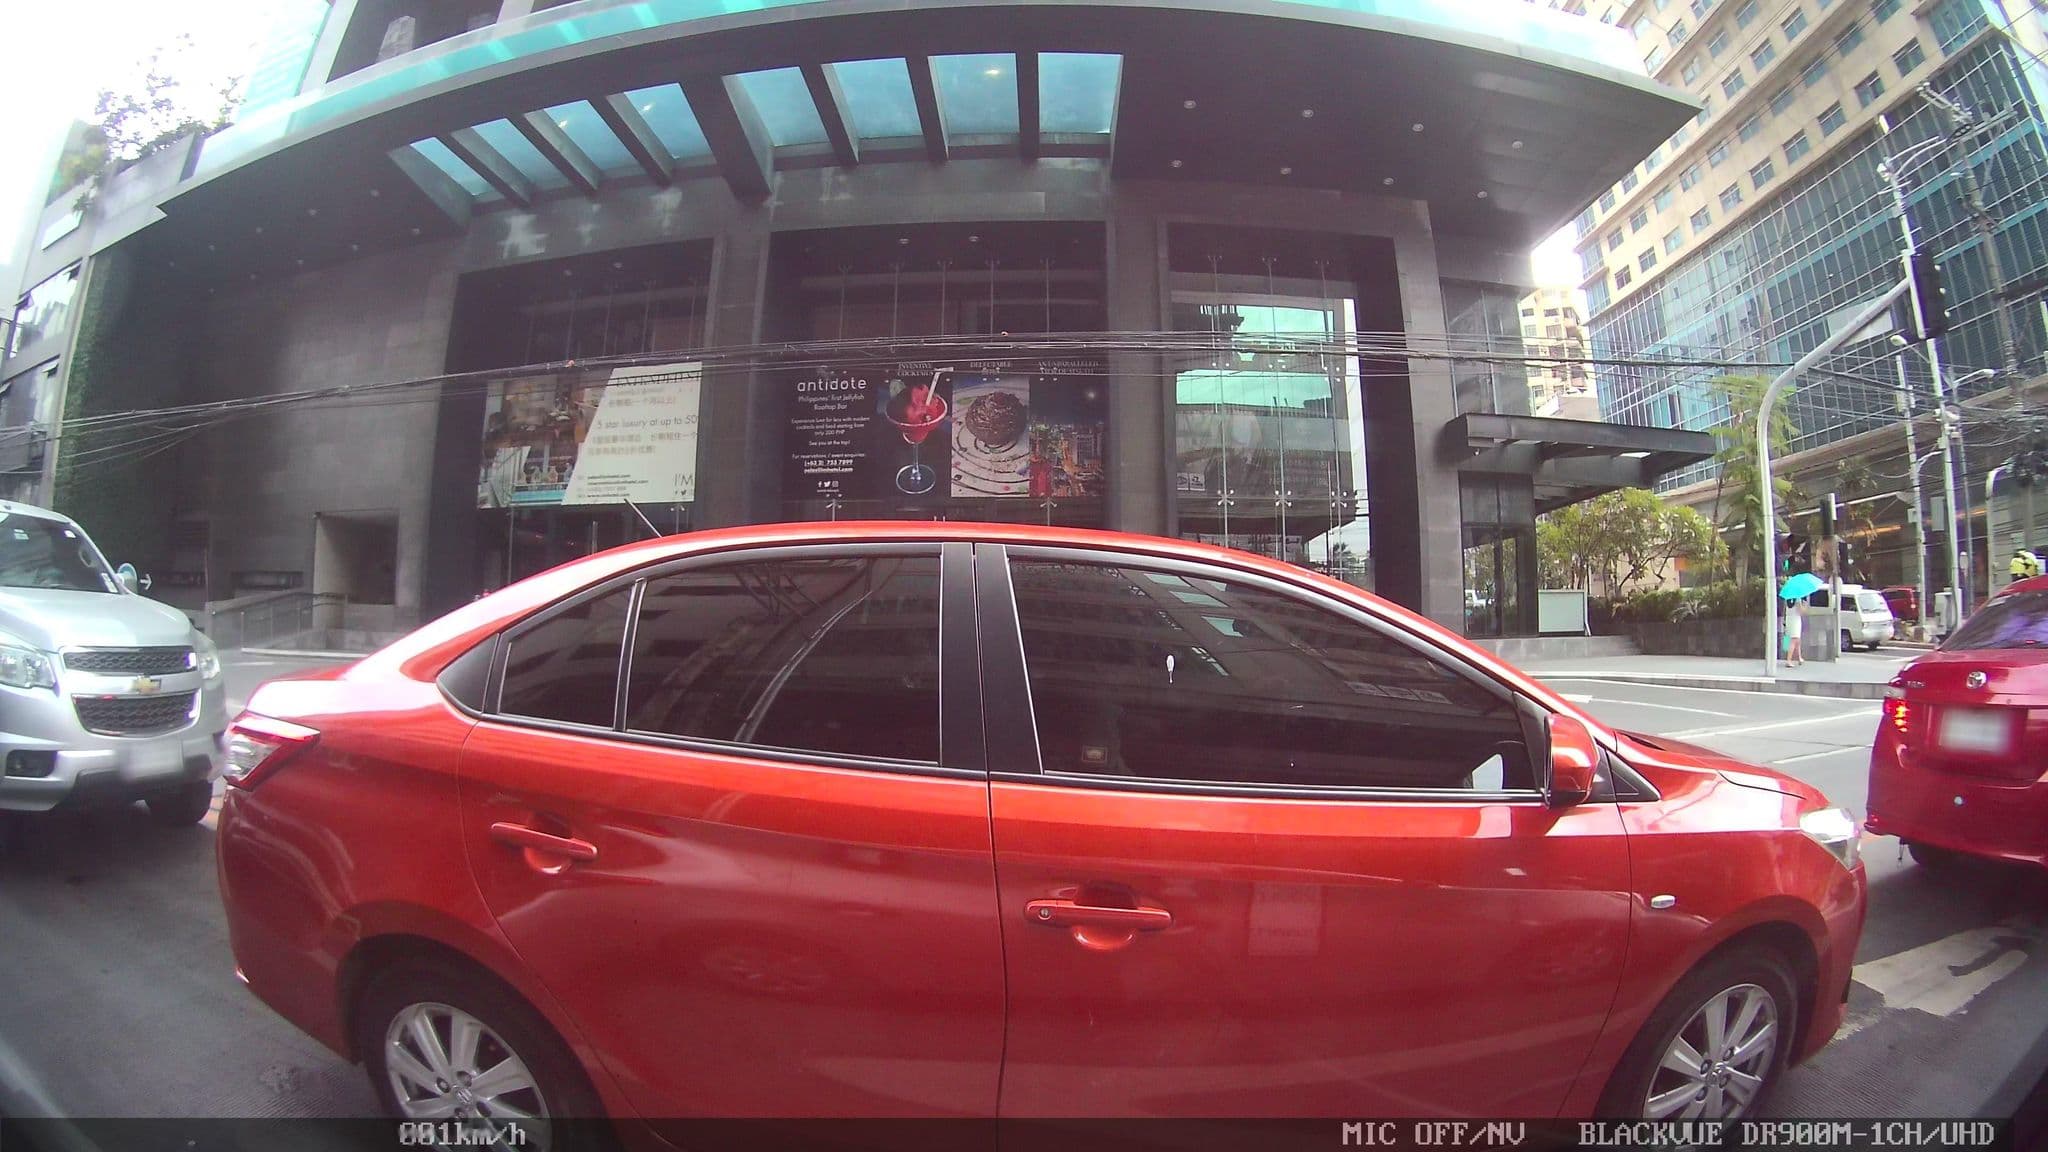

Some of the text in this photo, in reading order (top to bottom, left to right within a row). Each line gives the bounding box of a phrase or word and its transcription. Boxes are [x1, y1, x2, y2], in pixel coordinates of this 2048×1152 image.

[797, 377, 867, 391] antidote
[649, 418, 658, 426] at
[661, 419, 672, 429] up
[674, 416, 683, 425] to
